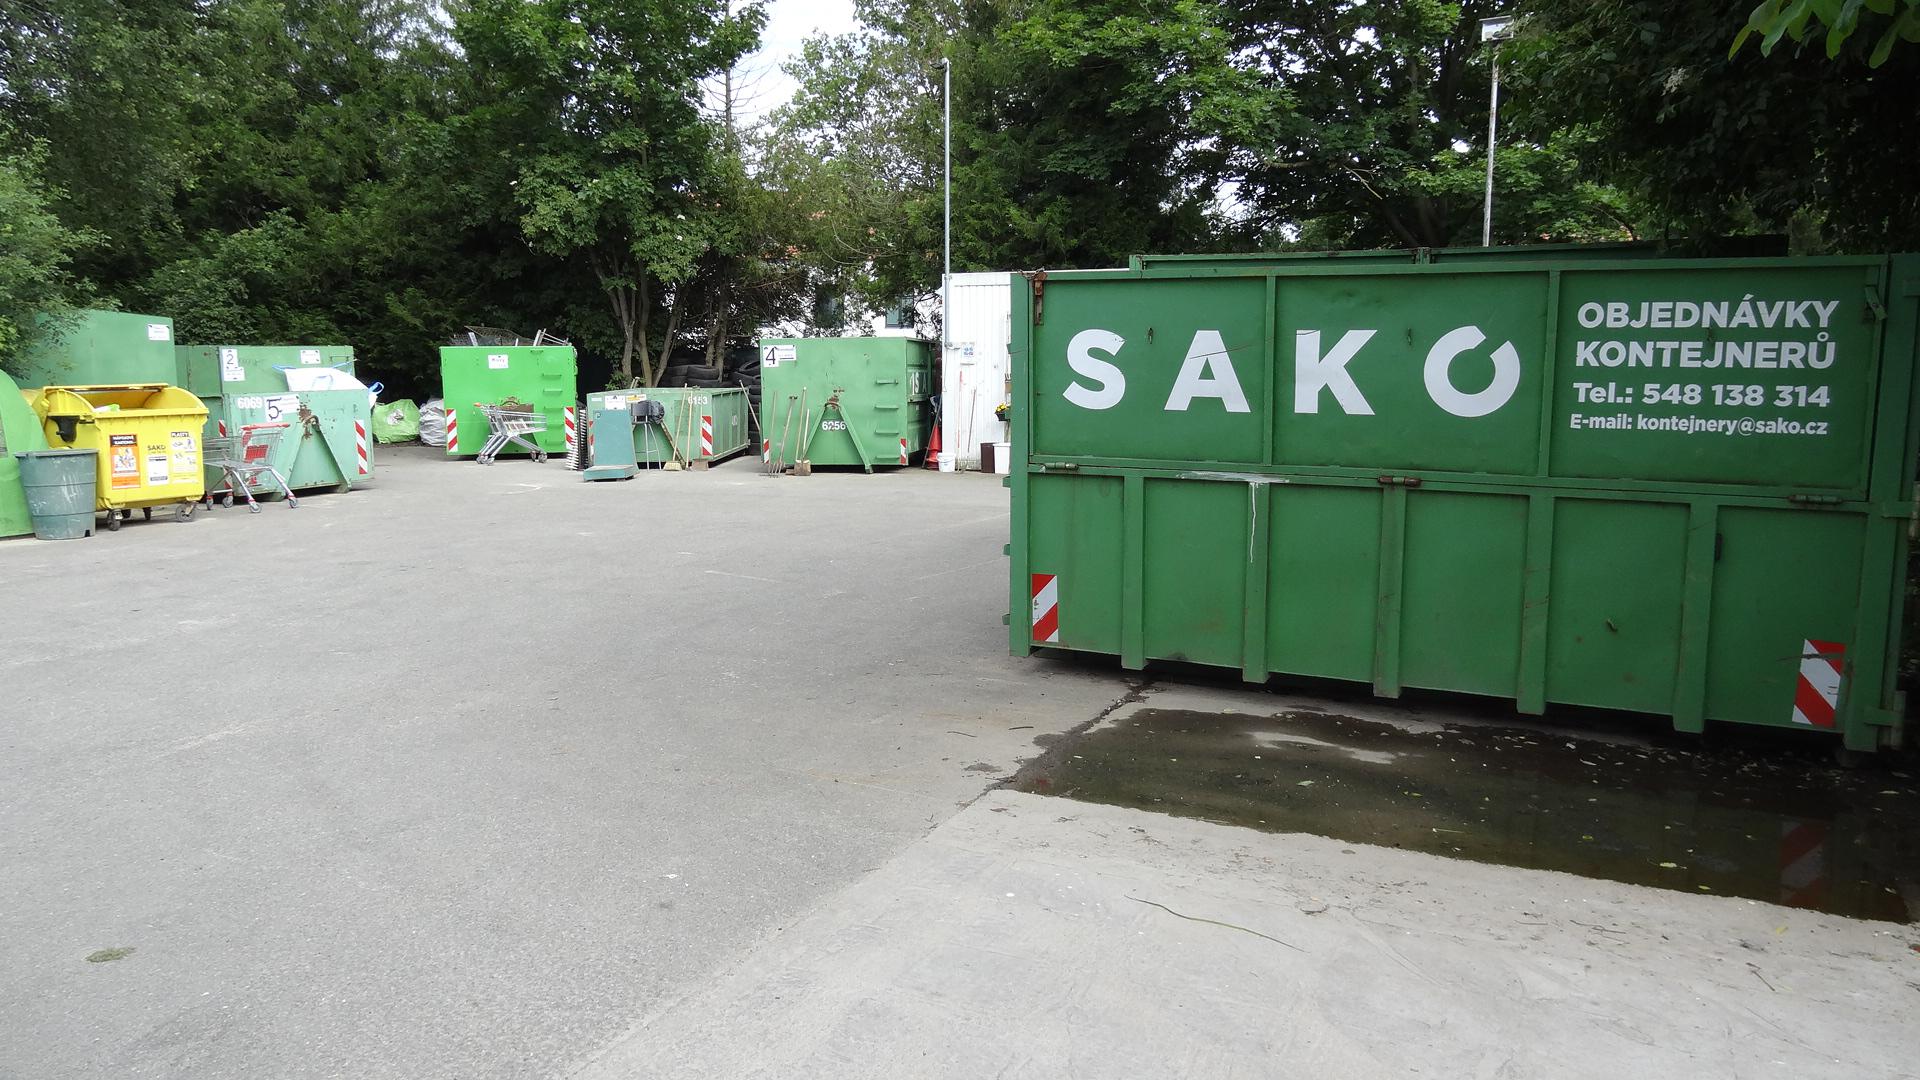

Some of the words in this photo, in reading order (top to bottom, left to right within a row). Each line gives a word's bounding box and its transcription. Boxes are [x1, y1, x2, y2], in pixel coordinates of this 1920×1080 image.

[1577, 294, 1840, 329] OBJEDNÁVKY
[226, 353, 235, 365] 2
[765, 346, 776, 365] 4
[1575, 332, 1836, 369] KONTEJNERŮ
[1062, 325, 1521, 418] SAKO
[1572, 382, 1634, 404] Tel.:
[1641, 383, 1702, 405] 548
[1711, 384, 1765, 406] 138
[1773, 385, 1830, 407] 314
[266, 398, 281, 420] 5
[821, 420, 846, 431] 6256
[1570, 413, 1633, 430] E-mail:
[1636, 414, 1828, 436] kontejnery@sako.cz
